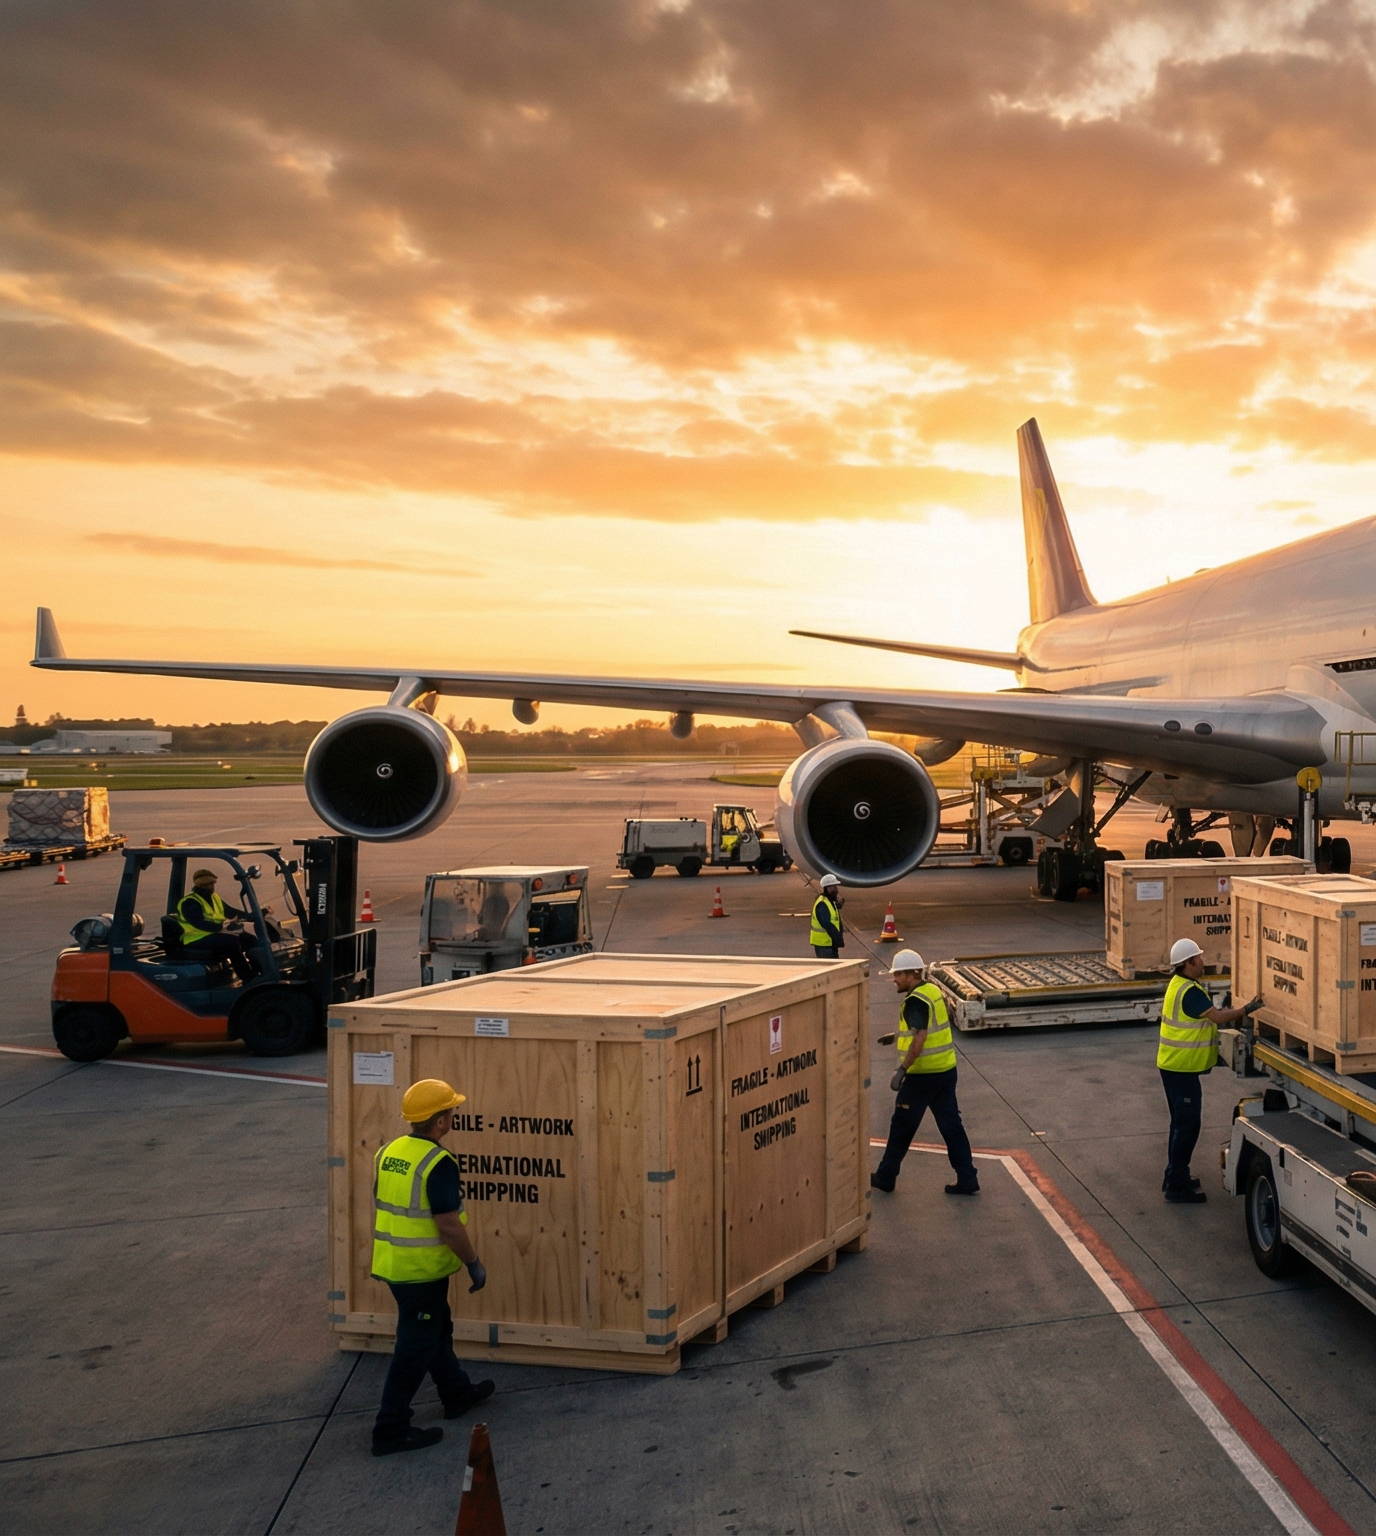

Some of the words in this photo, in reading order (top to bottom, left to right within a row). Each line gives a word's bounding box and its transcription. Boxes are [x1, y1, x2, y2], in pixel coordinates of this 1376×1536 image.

[1193, 913, 1232, 924] INTERNA
[1206, 925, 1232, 936] SHIPP
[731, 1066, 769, 1098] FRAGILE
[776, 1048, 818, 1080] ARTWORK
[740, 1087, 810, 1133] INTERNATIONAL
[451, 1113, 484, 1132] GILE
[498, 1115, 574, 1136] ARTWORK
[754, 1116, 797, 1151] SHIPPING
[453, 1153, 566, 1179] ERNATIONAL
